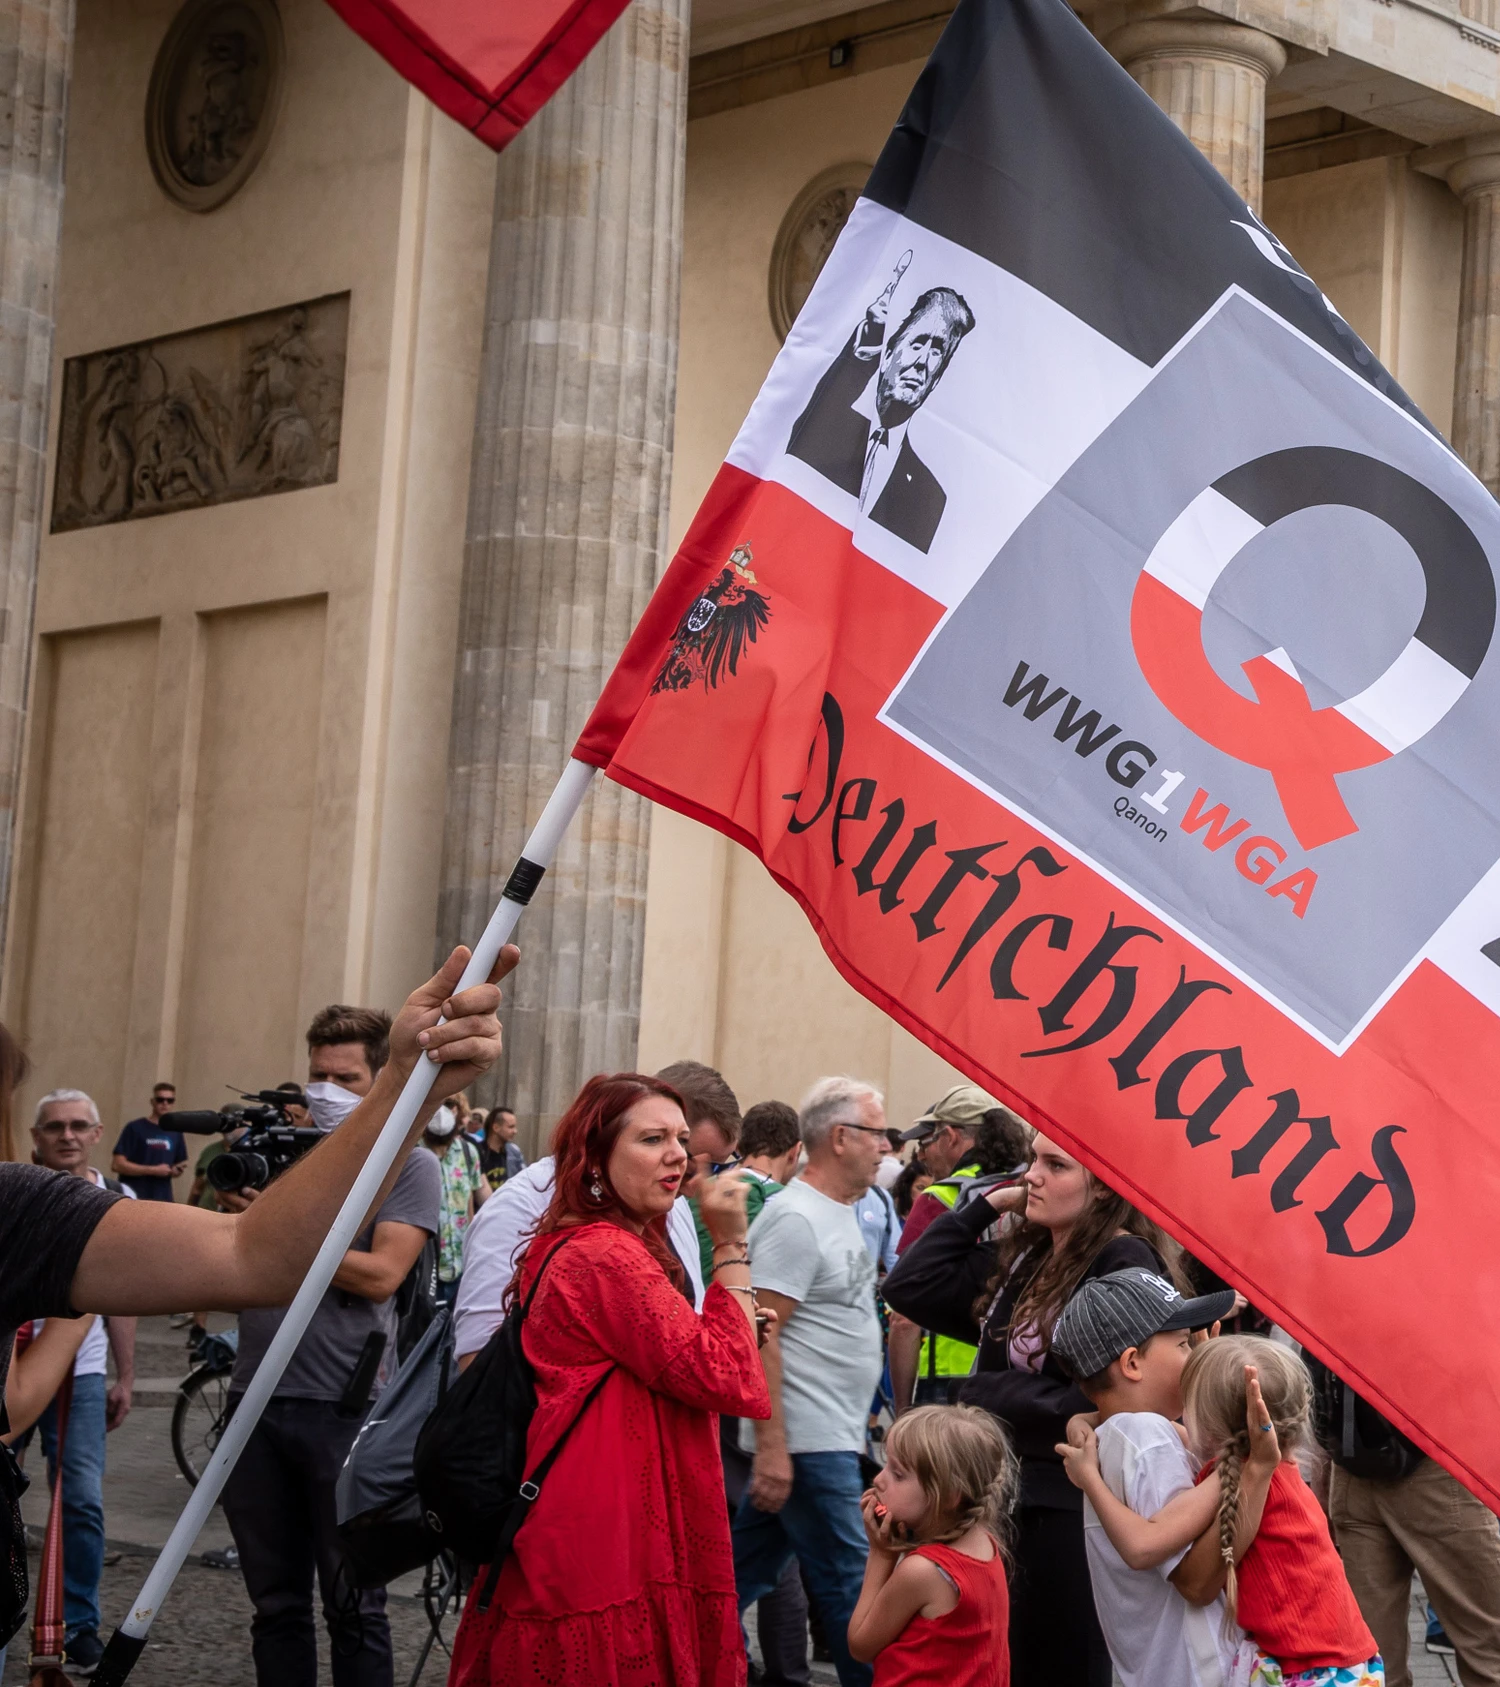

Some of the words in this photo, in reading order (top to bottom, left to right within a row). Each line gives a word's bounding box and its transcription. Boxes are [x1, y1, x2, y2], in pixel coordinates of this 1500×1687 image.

[1130, 445, 1497, 852] Q
[1001, 660, 1319, 920] WWG1WGA
[1112, 795, 1169, 843] Qanon
